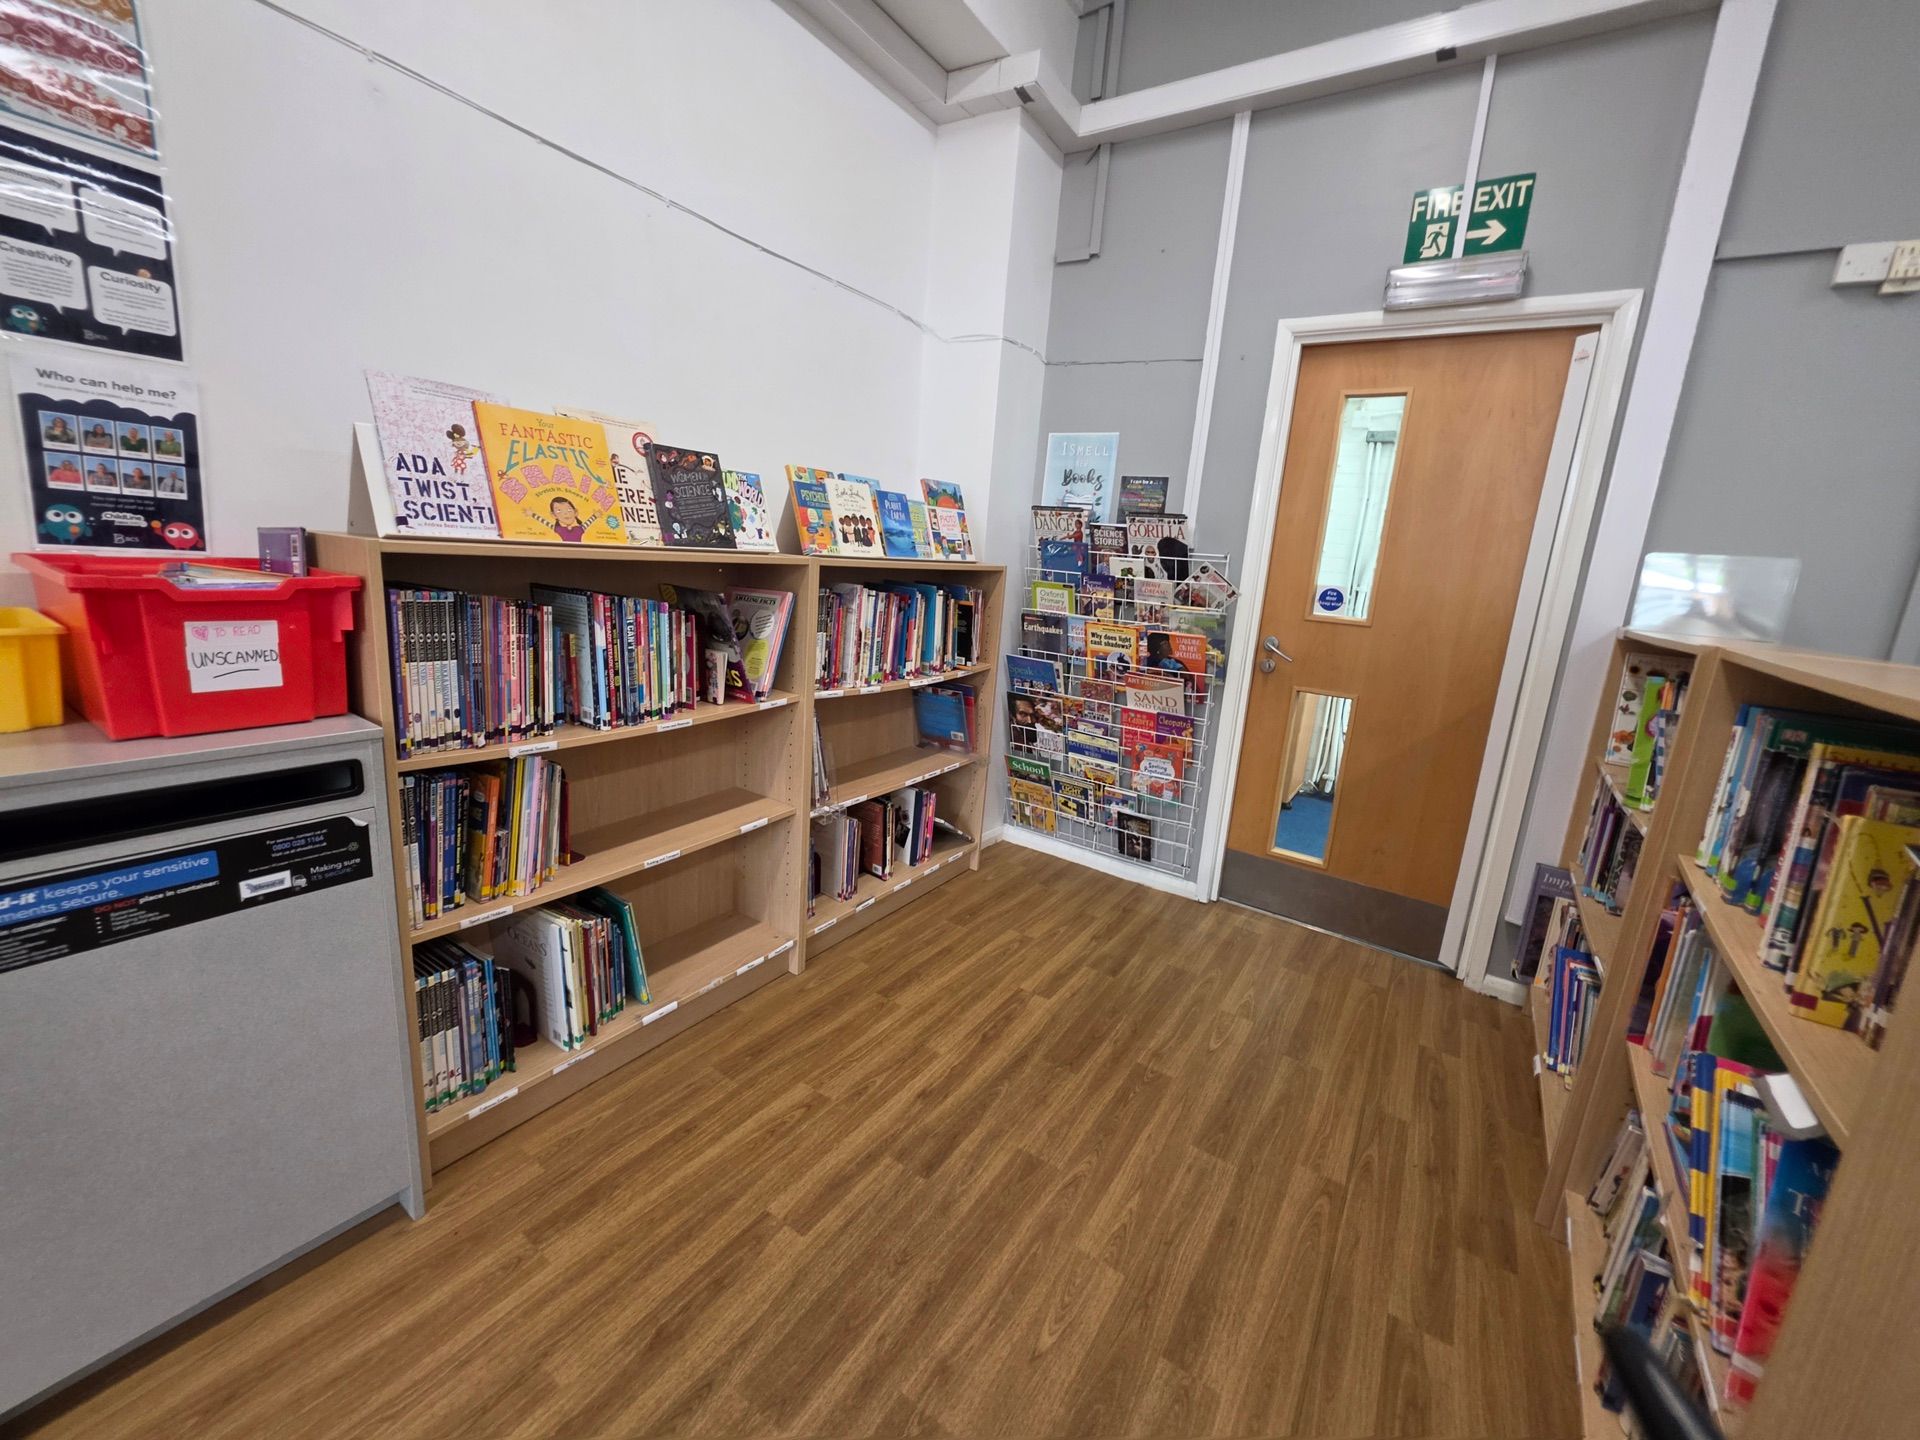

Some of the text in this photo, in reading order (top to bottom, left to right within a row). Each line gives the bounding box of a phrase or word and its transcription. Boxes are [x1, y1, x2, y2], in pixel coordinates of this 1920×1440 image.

[1411, 179, 1534, 223] FIRE EXIT
[0, 240, 73, 268] Creativity
[100, 271, 161, 294] Curiosity
[35, 367, 75, 383] Who
[80, 377, 107, 389] can
[112, 381, 143, 396] help
[148, 389, 177, 400] me?
[536, 418, 554, 429] Your
[498, 422, 593, 449] FANTASTIC
[396, 453, 447, 476] ADA
[505, 440, 600, 478] ELASTIC
[671, 471, 702, 484] WOMEN
[1061, 468, 1104, 491] Books
[398, 477, 478, 503] TWIST,
[499, 464, 616, 512] BRAIN
[673, 484, 712, 498] SCIENCE
[738, 481, 765, 508] WORLD
[618, 487, 655, 506] ERE,
[403, 500, 495, 524] SCIENTI
[884, 500, 902, 511] PLANET
[621, 506, 657, 524] INEE
[890, 510, 906, 522] EARTH
[1034, 516, 1075, 531] DANCE
[1128, 523, 1186, 540] GORILLA
[1093, 529, 1124, 539] SCIENCE
[1094, 536, 1125, 546] STORIES
[1040, 589, 1065, 599] Oxford
[214, 624, 262, 638] TO READ
[1023, 622, 1064, 635] Earthquakes
[627, 625, 635, 650] CAN'T
[1091, 632, 1132, 644] Why does light
[1104, 641, 1132, 650] shadows?
[191, 649, 279, 669] UNSCANNED
[1134, 692, 1177, 707] SAND
[1158, 716, 1191, 728] Cleopatra
[1012, 759, 1044, 775] School
[272, 842, 291, 851] 0800
[310, 858, 361, 874] Making sure
[0, 856, 210, 910] d-it keeps your sensitive
[1543, 873, 1570, 889] Imp
[0, 888, 125, 923] ments secure.
[139, 893, 164, 905] place
